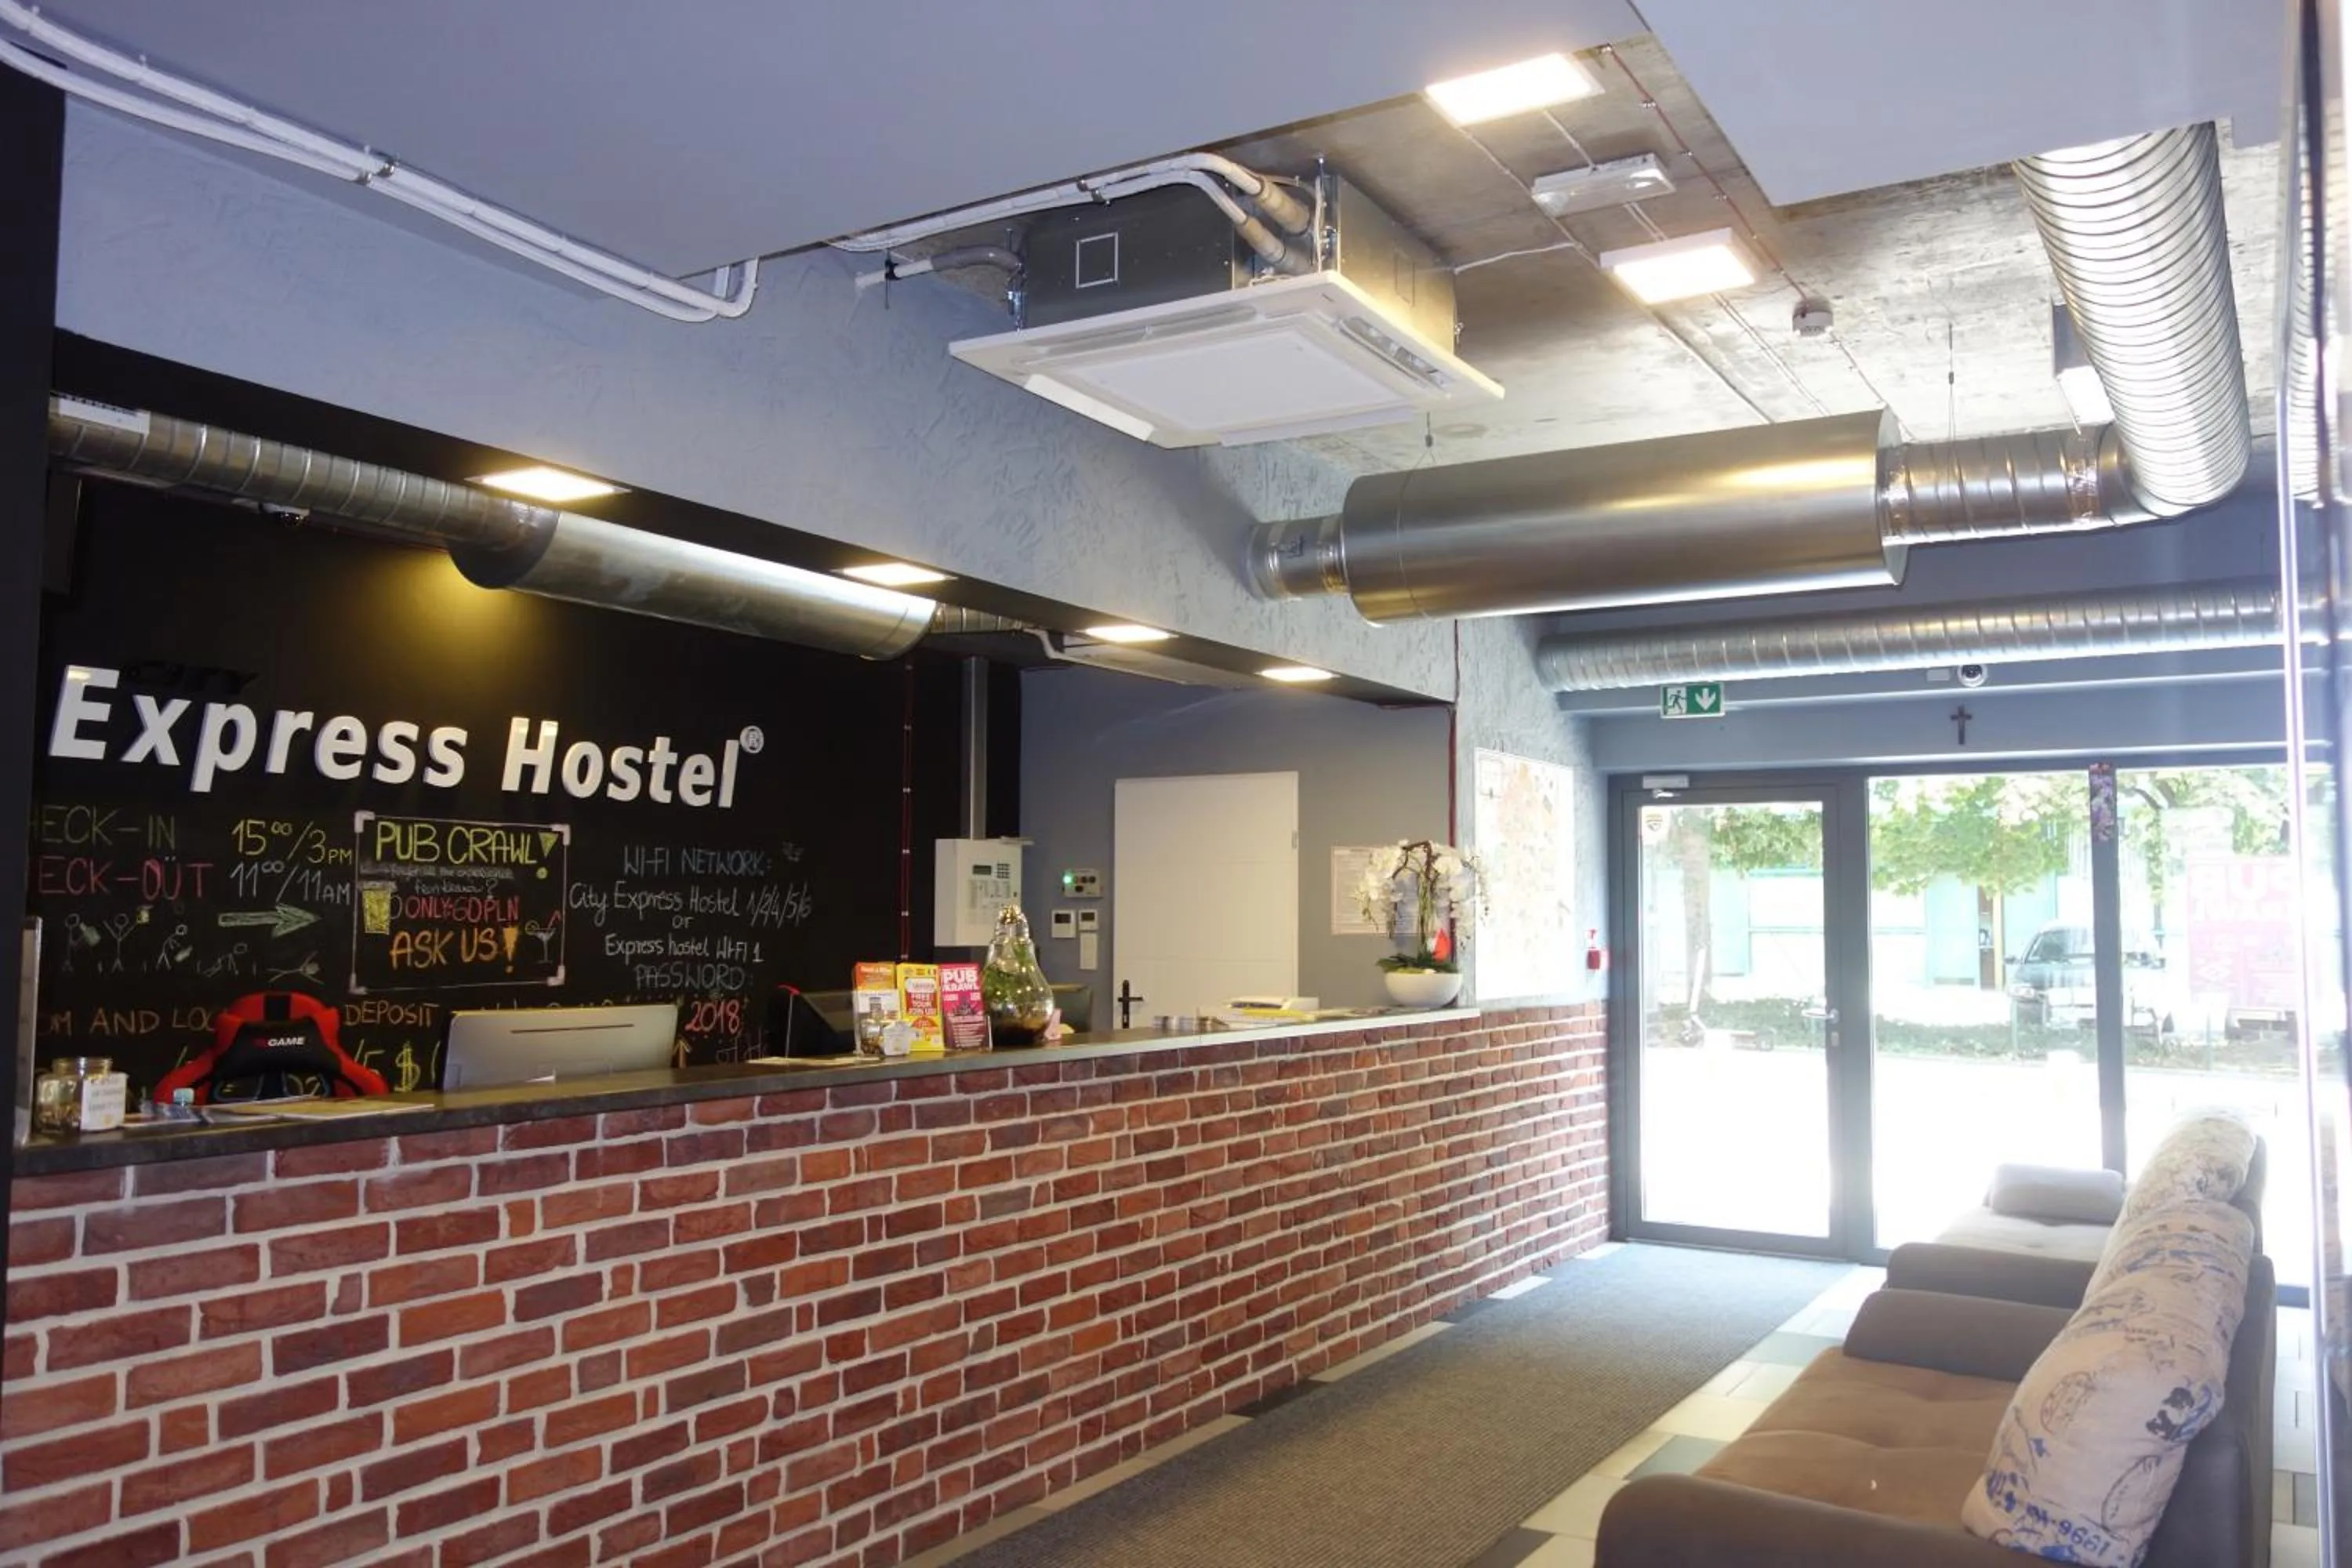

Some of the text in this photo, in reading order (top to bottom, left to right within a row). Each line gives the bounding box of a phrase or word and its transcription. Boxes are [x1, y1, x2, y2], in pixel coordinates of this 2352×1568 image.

[48, 663, 469, 793] Express
[376, 822, 440, 863] PUB
[568, 881, 608, 927] City
[614, 879, 684, 921] Express
[688, 884, 740, 916] Hostel
[389, 931, 454, 970] ASK
[604, 933, 665, 965] Express
[942, 968, 978, 983] PUB
[89, 1007, 160, 1036] AND
[343, 999, 440, 1029] DEPOSIT
[684, 1000, 742, 1035] 2018
